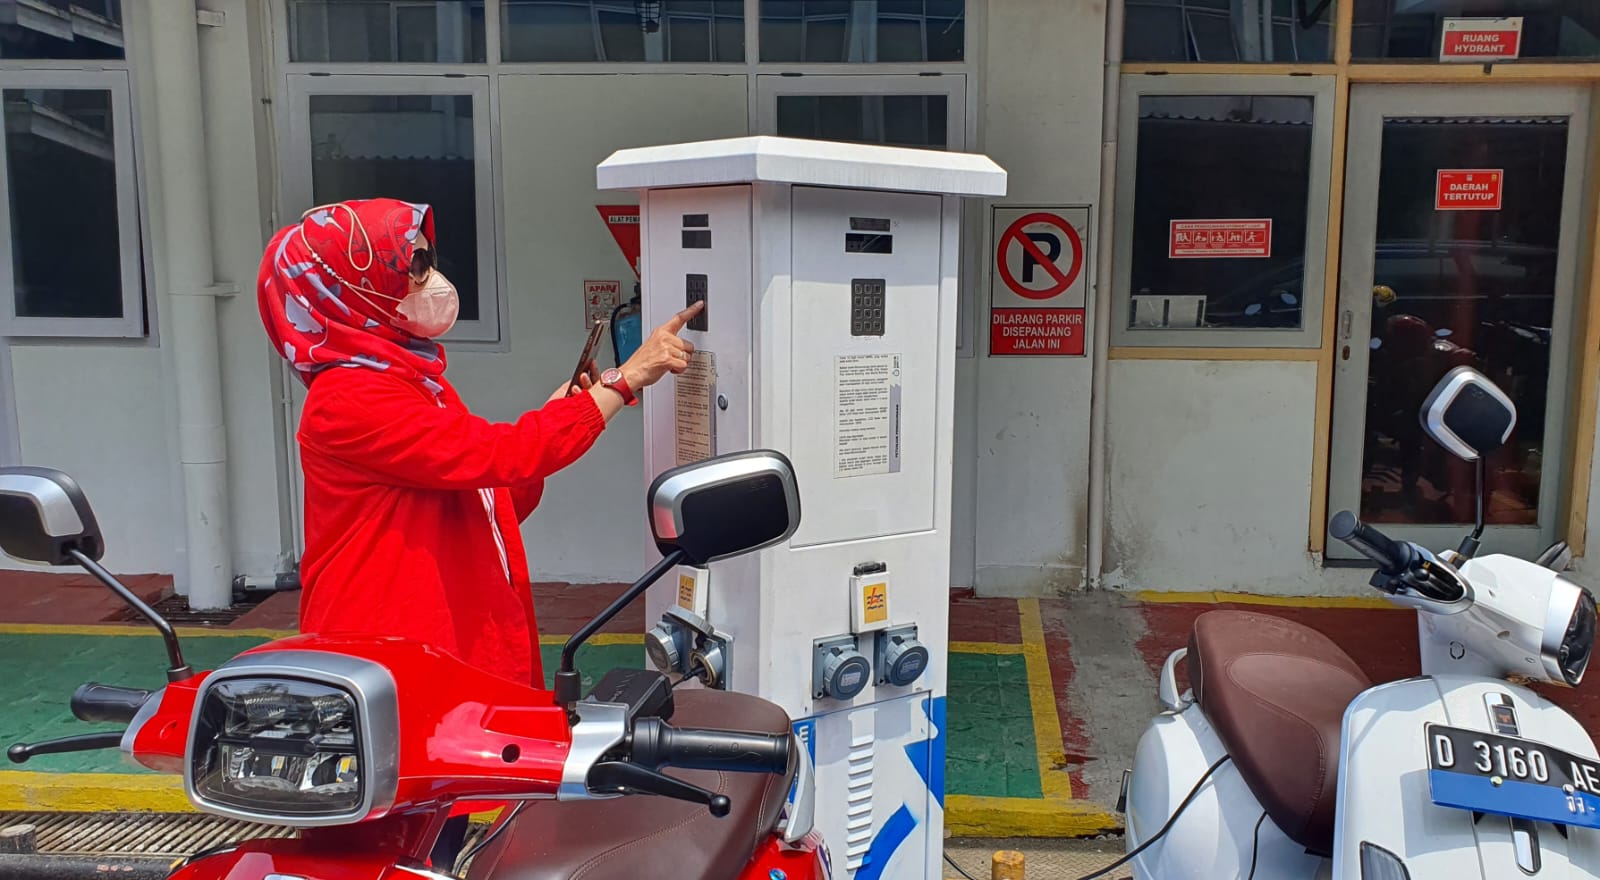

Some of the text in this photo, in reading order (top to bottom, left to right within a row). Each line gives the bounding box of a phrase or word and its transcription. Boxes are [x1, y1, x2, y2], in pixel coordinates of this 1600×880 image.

[1462, 34, 1500, 42] RUANG
[1454, 44, 1506, 53] HYDRANT
[1450, 183, 1489, 191] DAERAH
[992, 313, 1082, 324] DILARANG PARKIR
[1003, 326, 1071, 337] DISEPANJANG
[1013, 338, 1060, 349] JALAN INI
[1435, 734, 1455, 767] D
[1473, 740, 1549, 783] 3160
